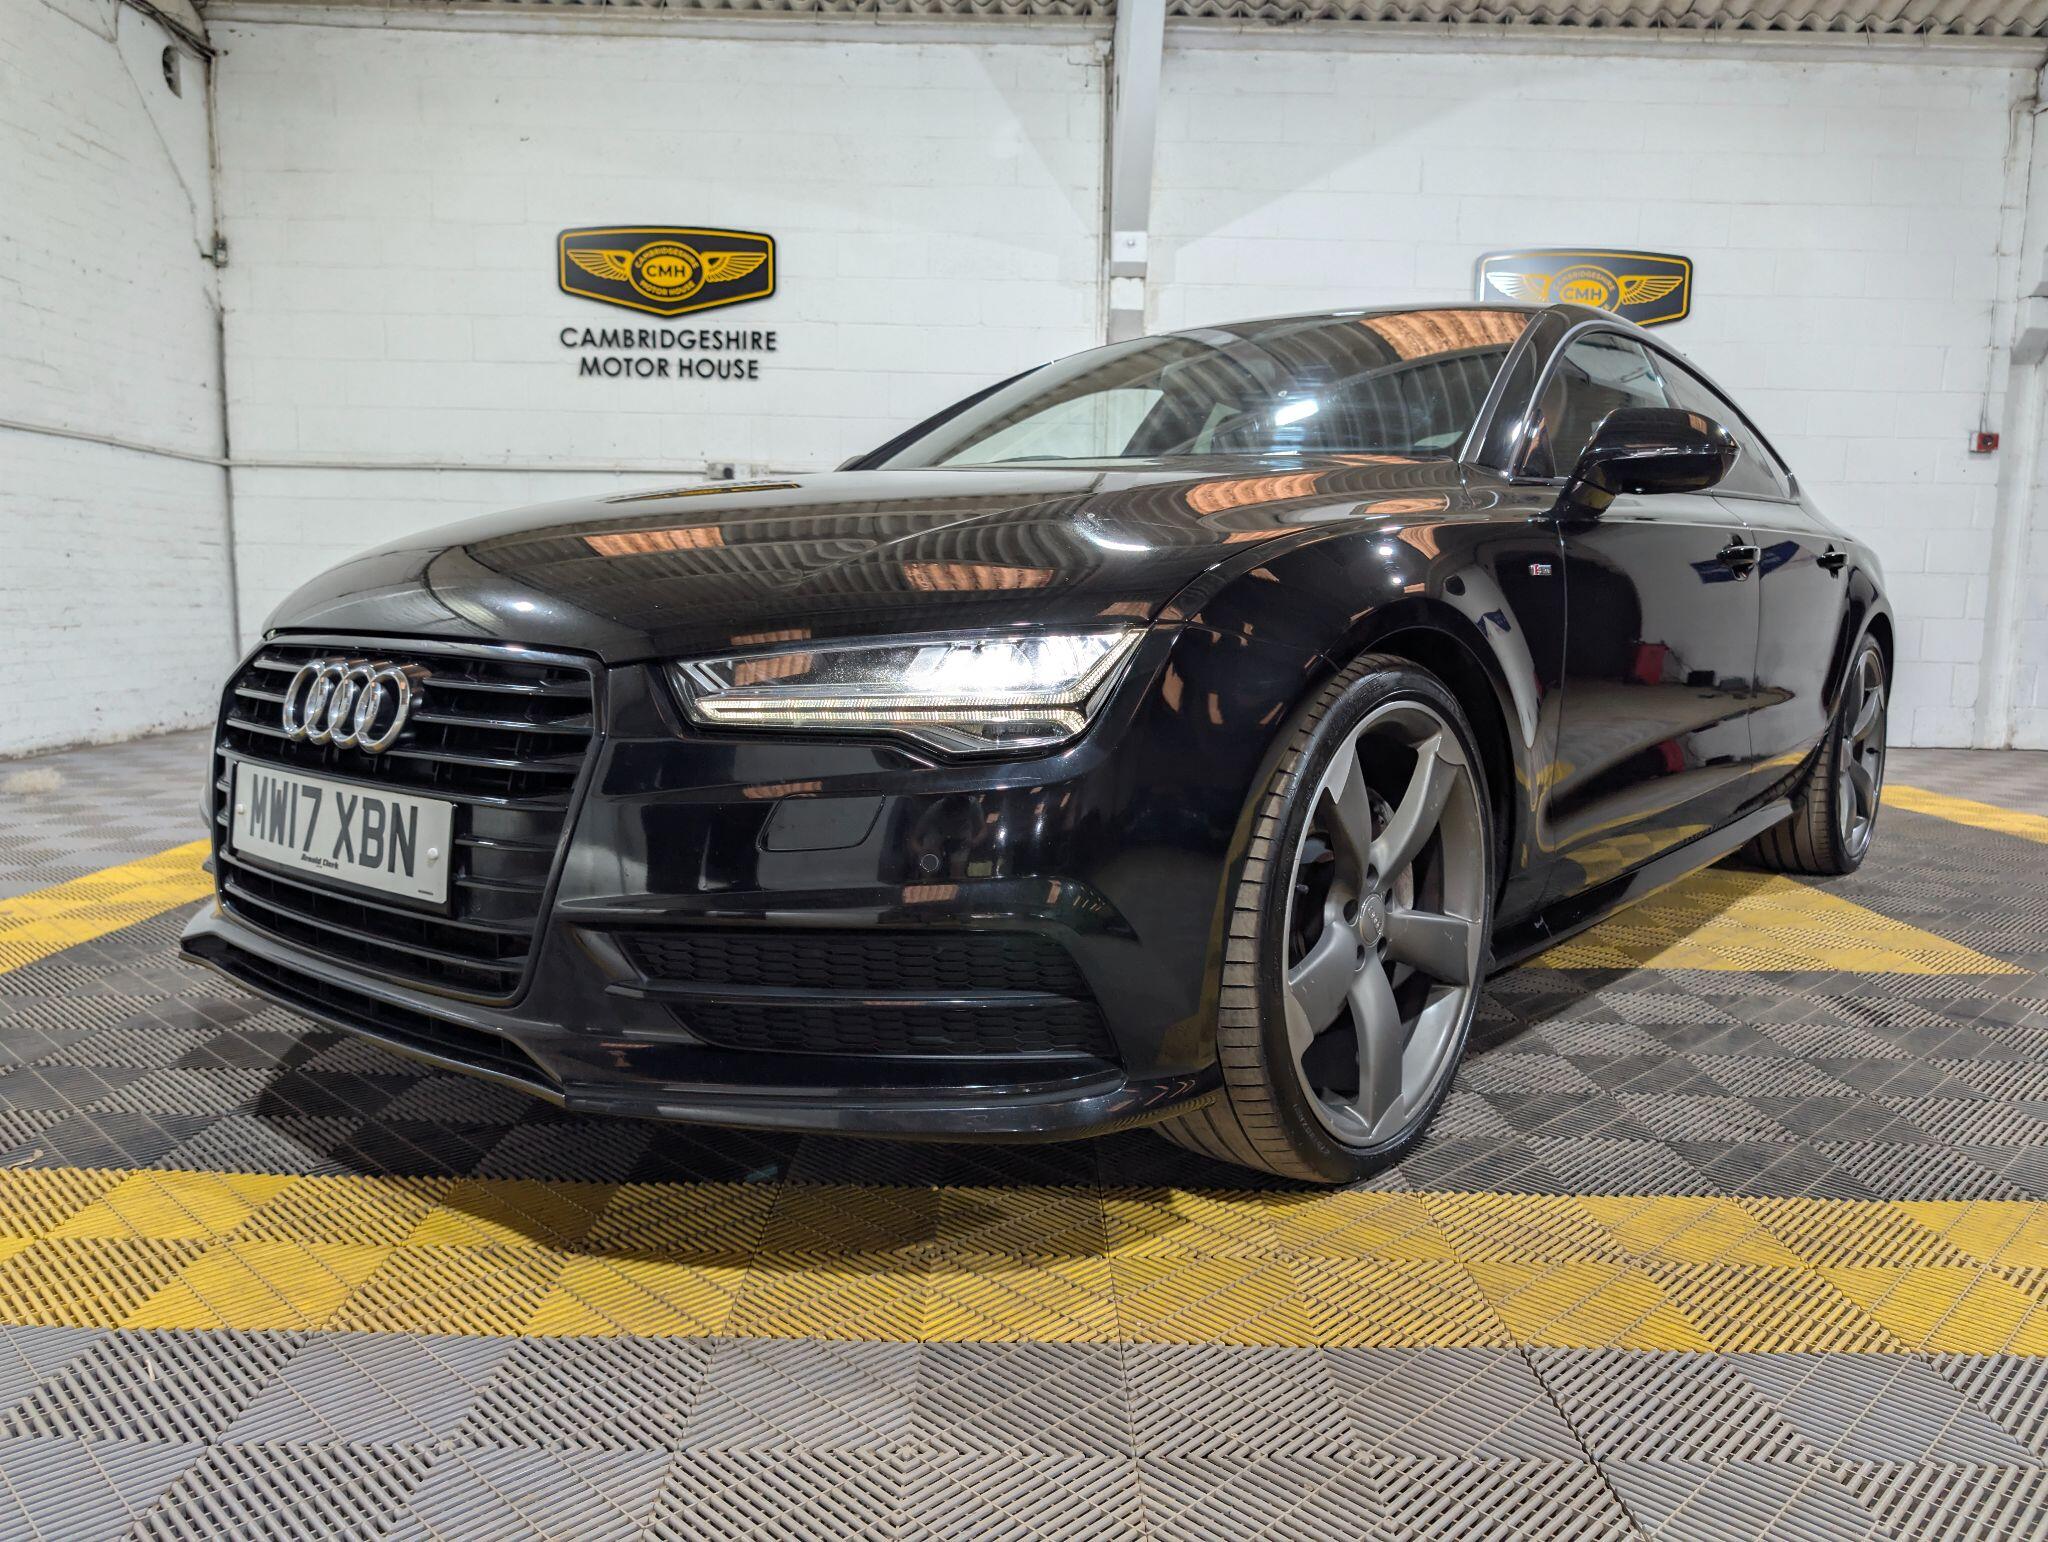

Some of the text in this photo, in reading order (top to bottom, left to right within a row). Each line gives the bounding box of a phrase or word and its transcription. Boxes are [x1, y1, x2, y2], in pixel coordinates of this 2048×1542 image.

[647, 265, 686, 278] CMH
[1563, 287, 1602, 301] CMH
[560, 327, 777, 351] CAMBRIDGESHIRE
[579, 357, 759, 380] MOTOR HOUSE
[249, 773, 418, 878] MW17 XBN
